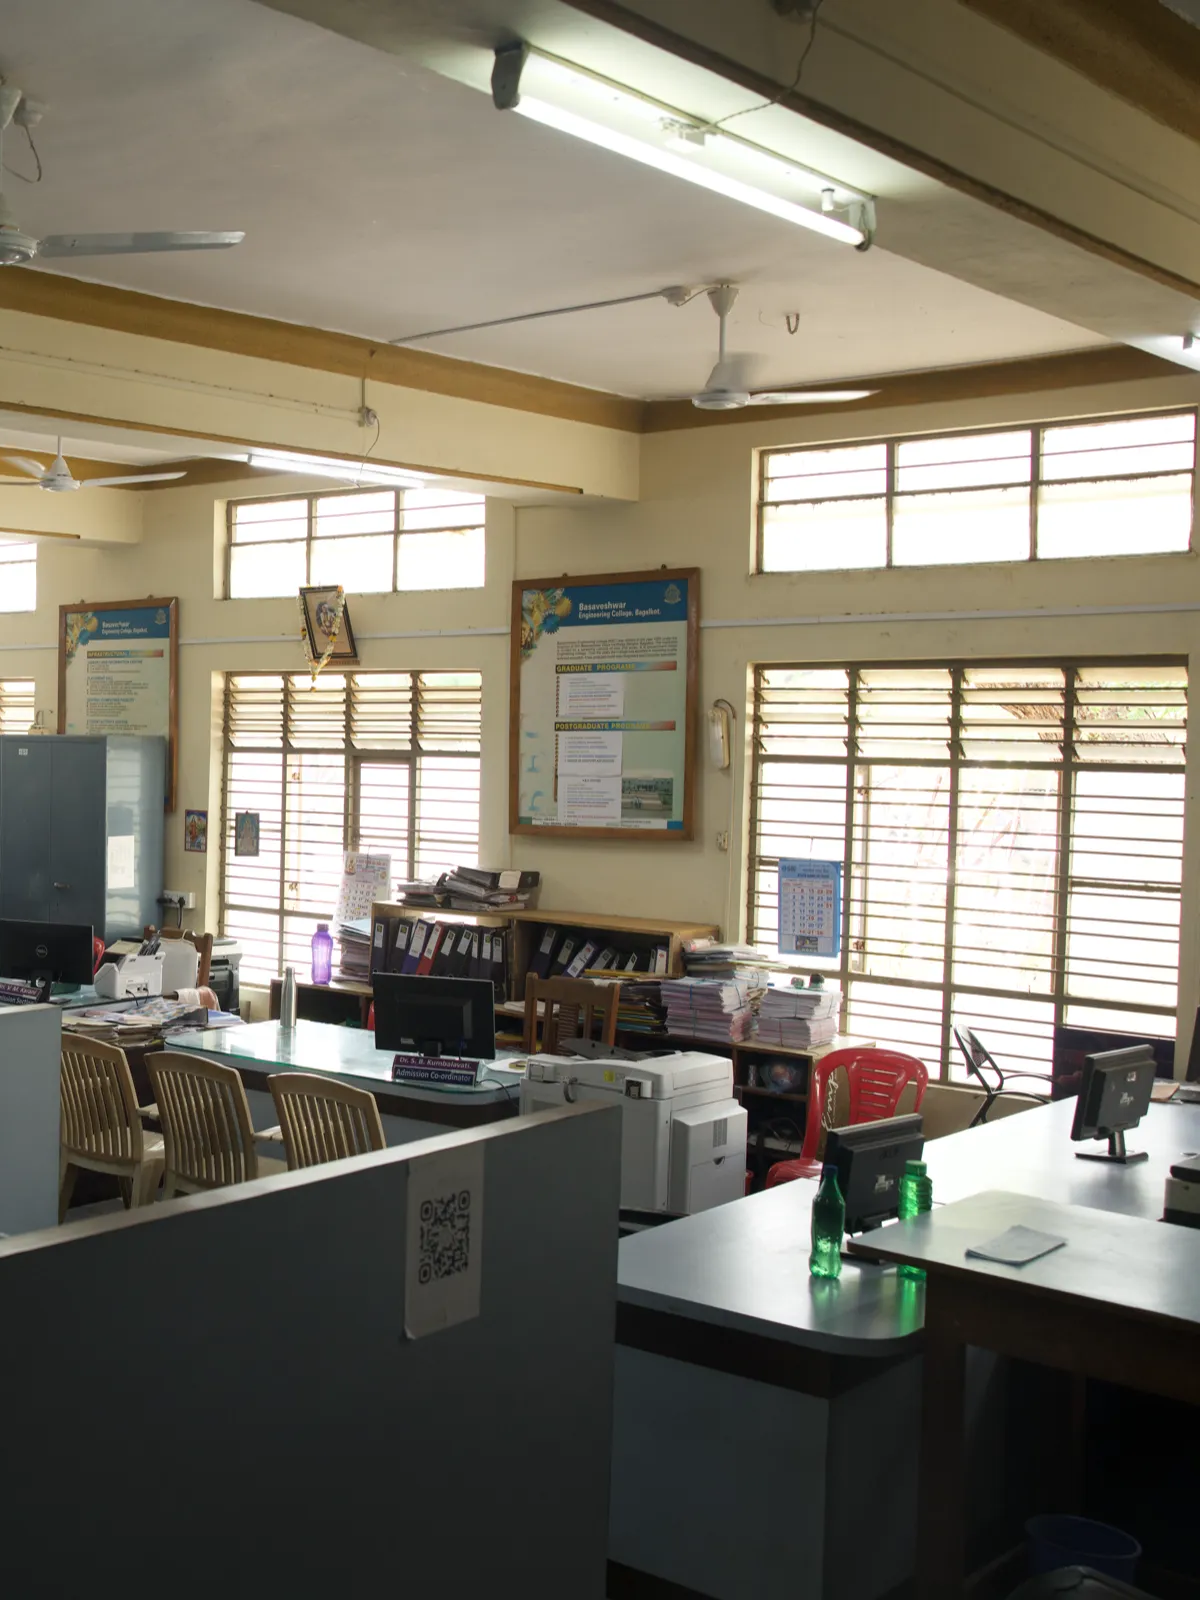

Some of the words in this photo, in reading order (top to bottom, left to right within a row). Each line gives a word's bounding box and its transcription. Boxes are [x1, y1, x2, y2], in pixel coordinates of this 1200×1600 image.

[579, 601, 626, 611] Basaveshwar
[578, 610, 610, 620] Engineering
[556, 664, 592, 672] GRADUATE
[396, 1069, 429, 1078] Admission
[430, 1072, 471, 1082] Co-ordinator
